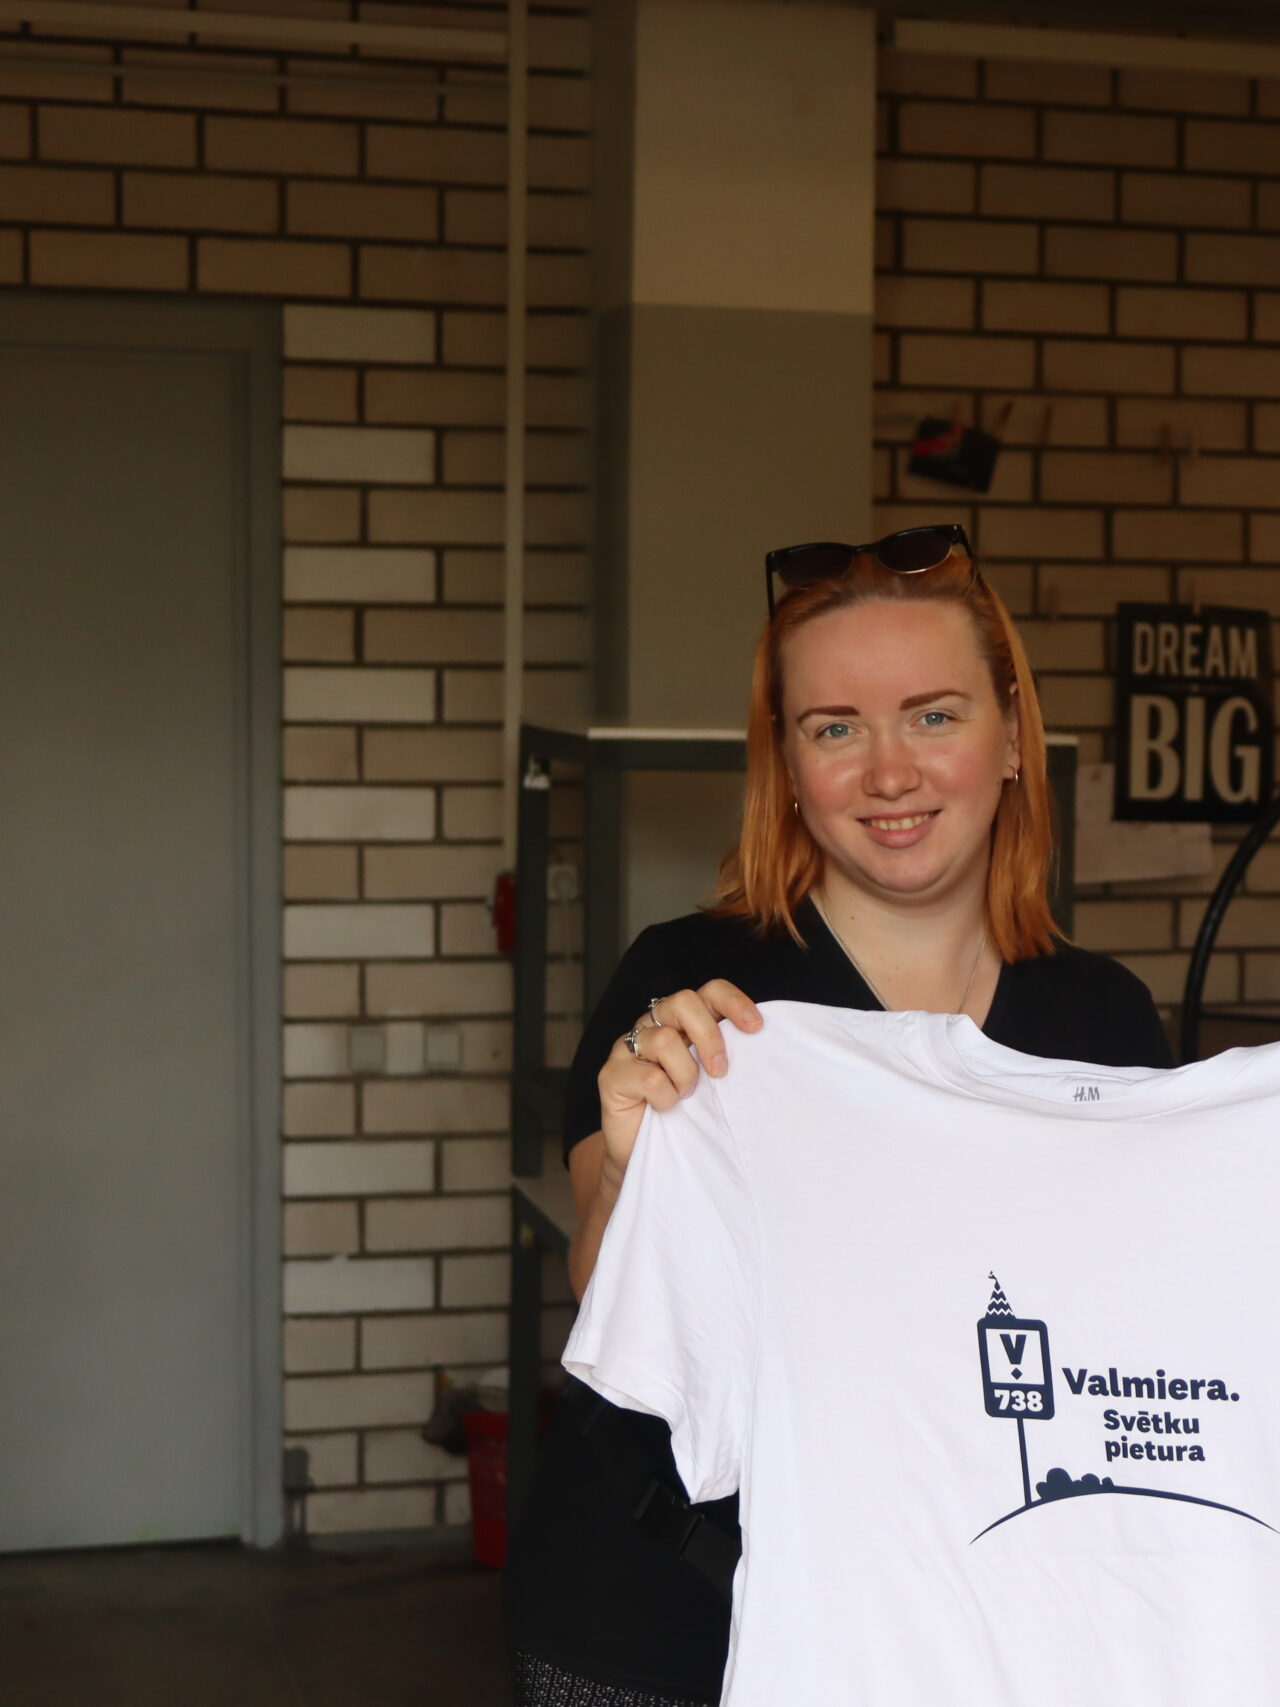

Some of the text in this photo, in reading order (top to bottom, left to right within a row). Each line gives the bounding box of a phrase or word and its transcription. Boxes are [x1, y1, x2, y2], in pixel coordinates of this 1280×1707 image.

[1133, 622, 1258, 679] DREAM
[1129, 694, 1261, 804] BIG
[1062, 1367, 1240, 1402] Valmiera.
[993, 1388, 1044, 1413] 738
[1103, 1409, 1200, 1435] Svētku
[1104, 1435, 1206, 1462] pietura
